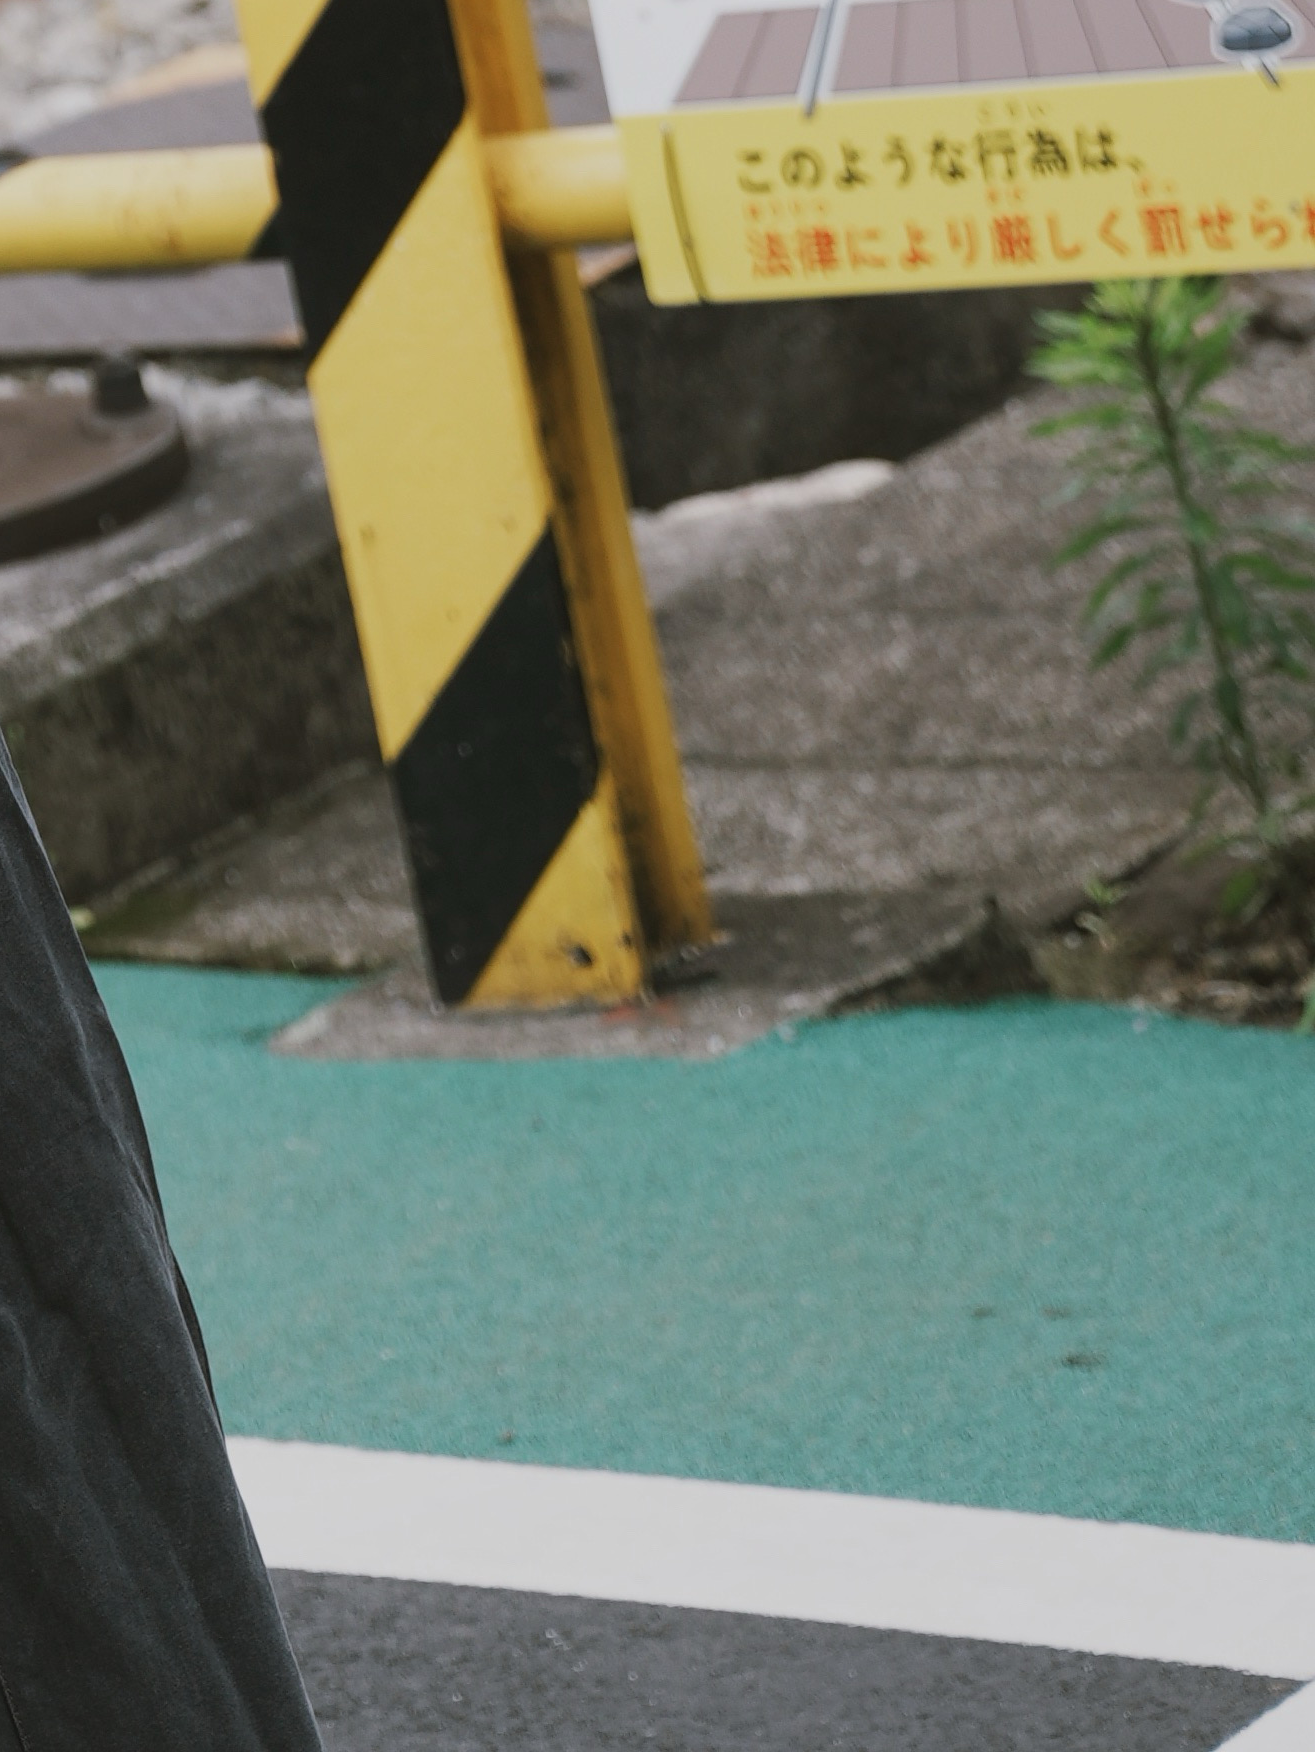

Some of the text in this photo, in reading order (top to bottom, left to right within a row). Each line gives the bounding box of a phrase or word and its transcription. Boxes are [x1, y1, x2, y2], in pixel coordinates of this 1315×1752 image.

[745, 199, 1315, 279] 法律により厳しく罰せら
